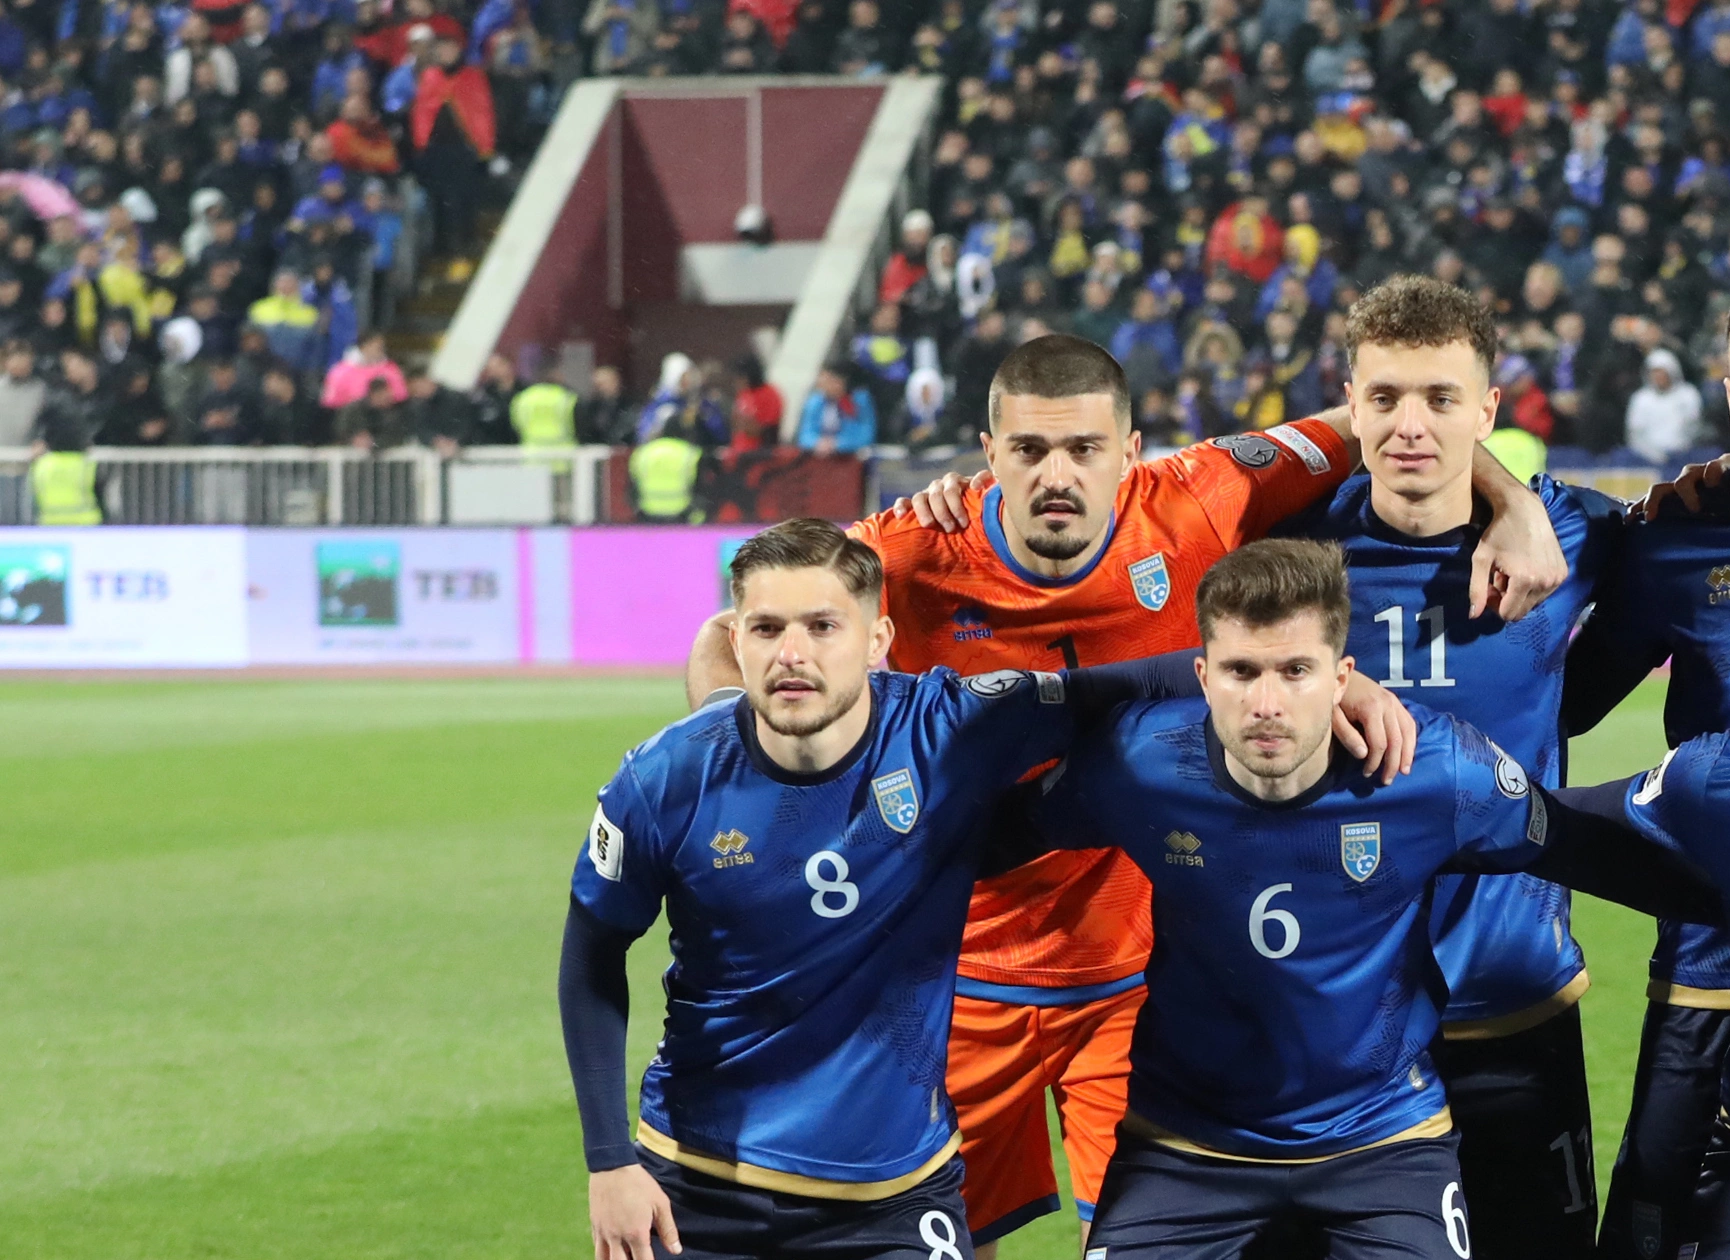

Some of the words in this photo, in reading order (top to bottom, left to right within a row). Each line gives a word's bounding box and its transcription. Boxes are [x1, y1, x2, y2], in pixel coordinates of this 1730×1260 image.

[1132, 558, 1160, 574] KOSOVA
[85, 570, 169, 602] TEB
[413, 570, 498, 602] TEB
[1374, 605, 1456, 687] 11
[877, 773, 907, 790] KOSOVA
[1345, 828, 1376, 836] KOSOVA
[713, 852, 754, 869] errea
[805, 850, 860, 918] 8
[1248, 883, 1300, 959] 6
[1442, 1181, 1471, 1260] 6
